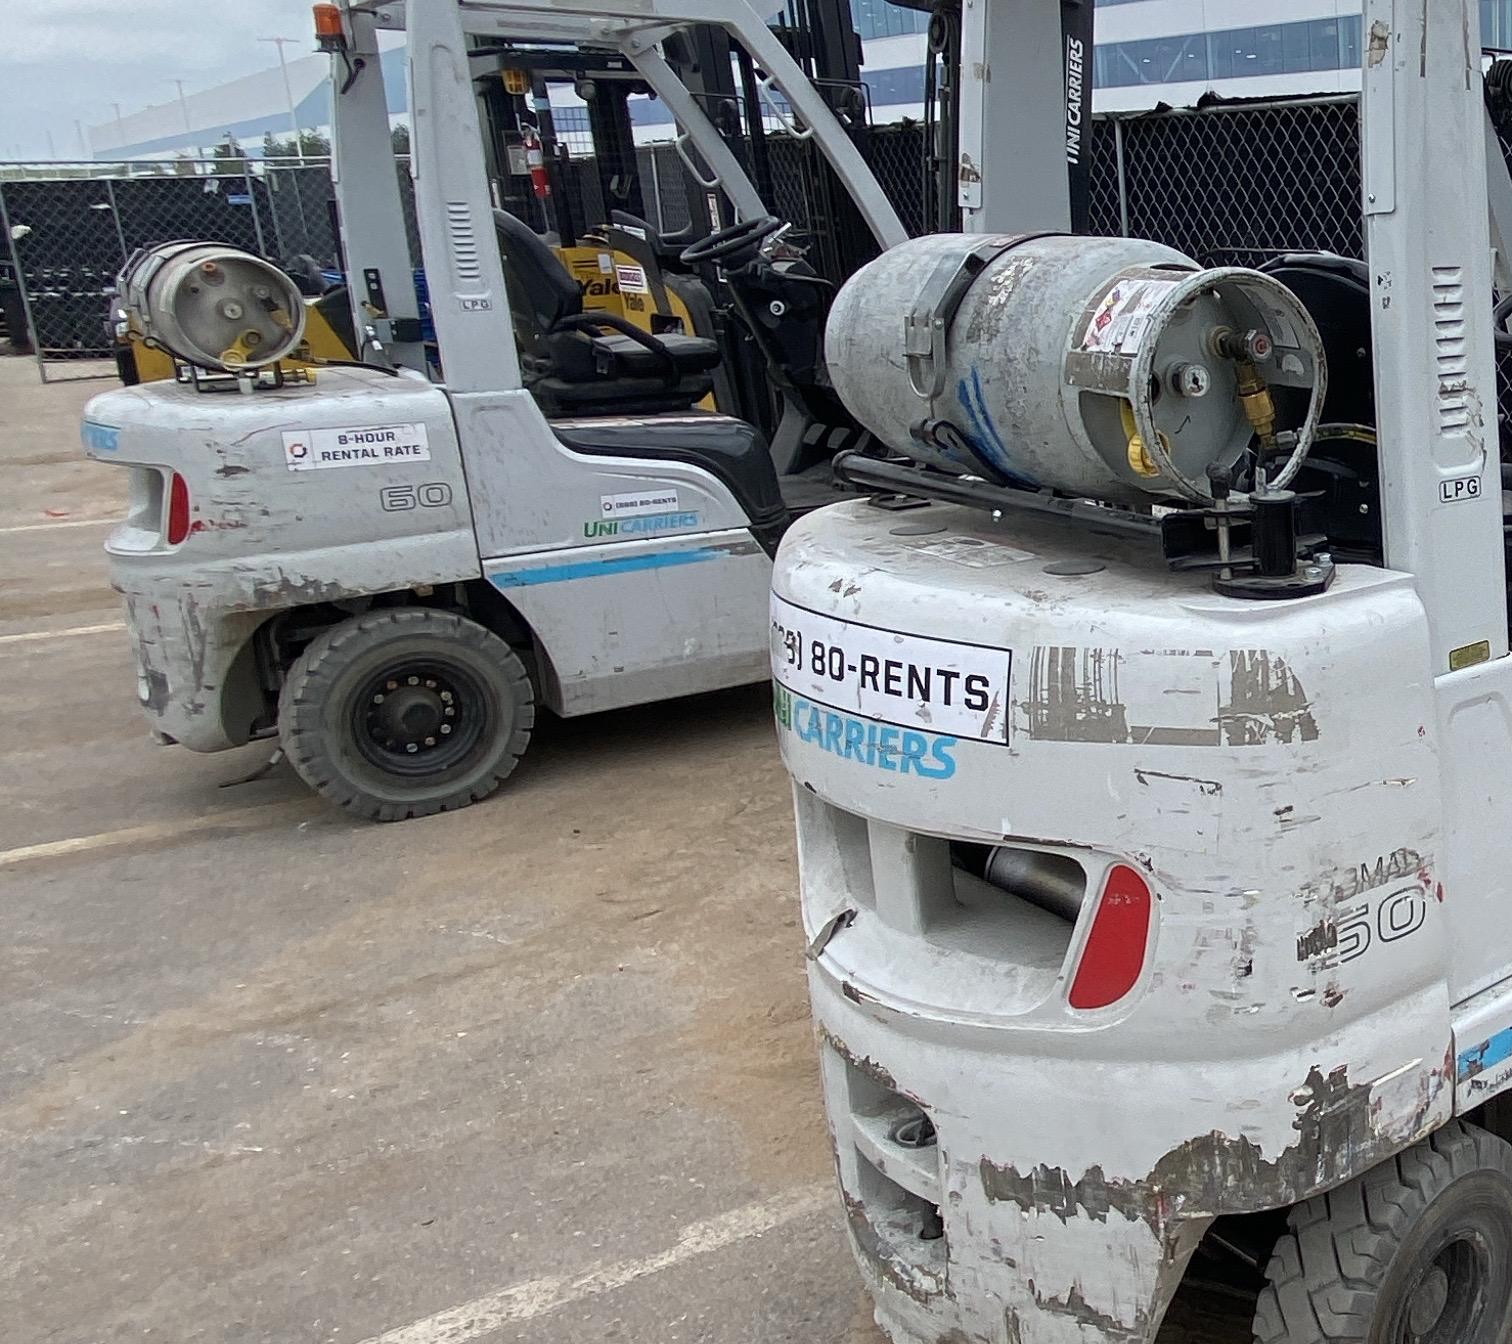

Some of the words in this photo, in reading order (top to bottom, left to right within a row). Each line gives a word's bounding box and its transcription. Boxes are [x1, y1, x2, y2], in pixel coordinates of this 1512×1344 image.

[338, 431, 395, 445] 8-HOUR
[321, 448, 379, 461] RENTAL
[384, 444, 421, 457] RATE
[379, 482, 452, 512] 60
[1443, 479, 1478, 499] LPG
[811, 640, 990, 712] 80-RENTS
